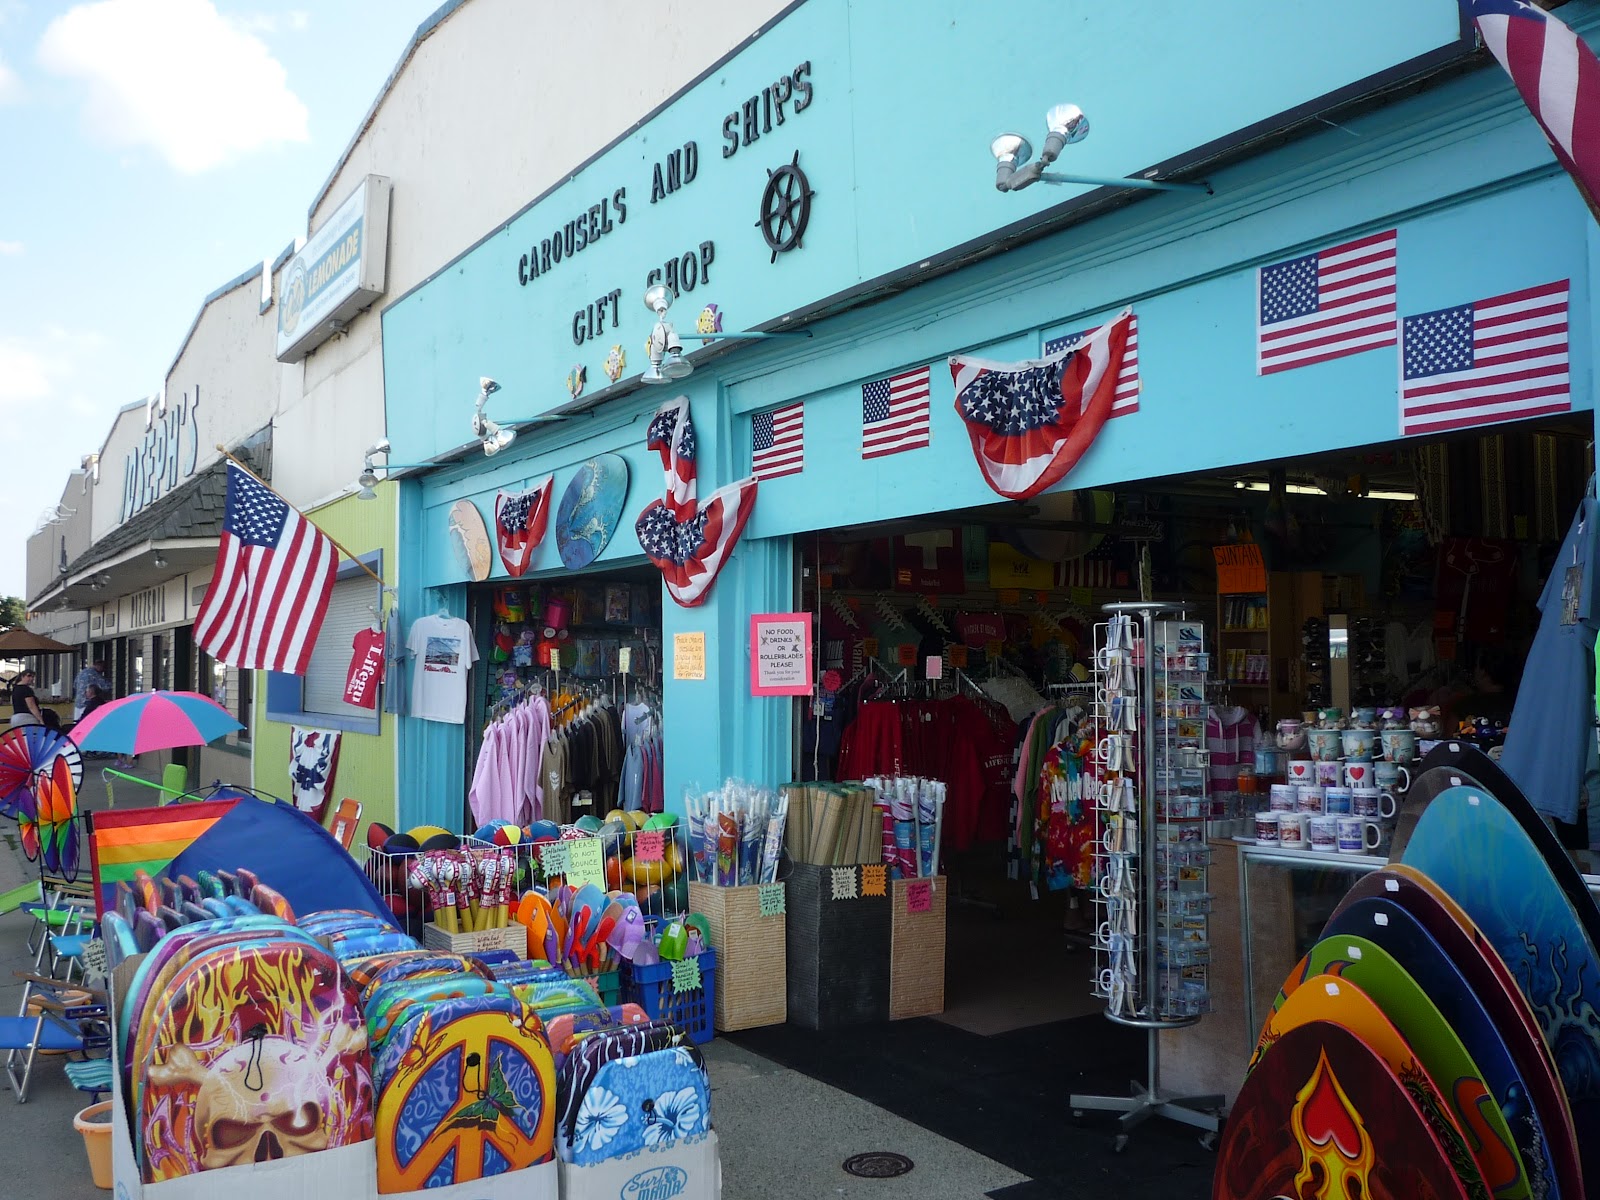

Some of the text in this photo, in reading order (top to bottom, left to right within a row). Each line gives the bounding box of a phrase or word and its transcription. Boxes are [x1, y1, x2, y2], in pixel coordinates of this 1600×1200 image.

[518, 60, 813, 286] CAROUSELS AND SHIPS
[308, 228, 359, 298] LEMONADE
[571, 288, 622, 346] GIFT
[118, 384, 199, 525] JOSEPH'S
[1214, 545, 1259, 567] SUNTAN
[569, 840, 597, 849] PLEASE
[570, 859, 598, 868] BOUNCE
[628, 1167, 666, 1192] Surf
